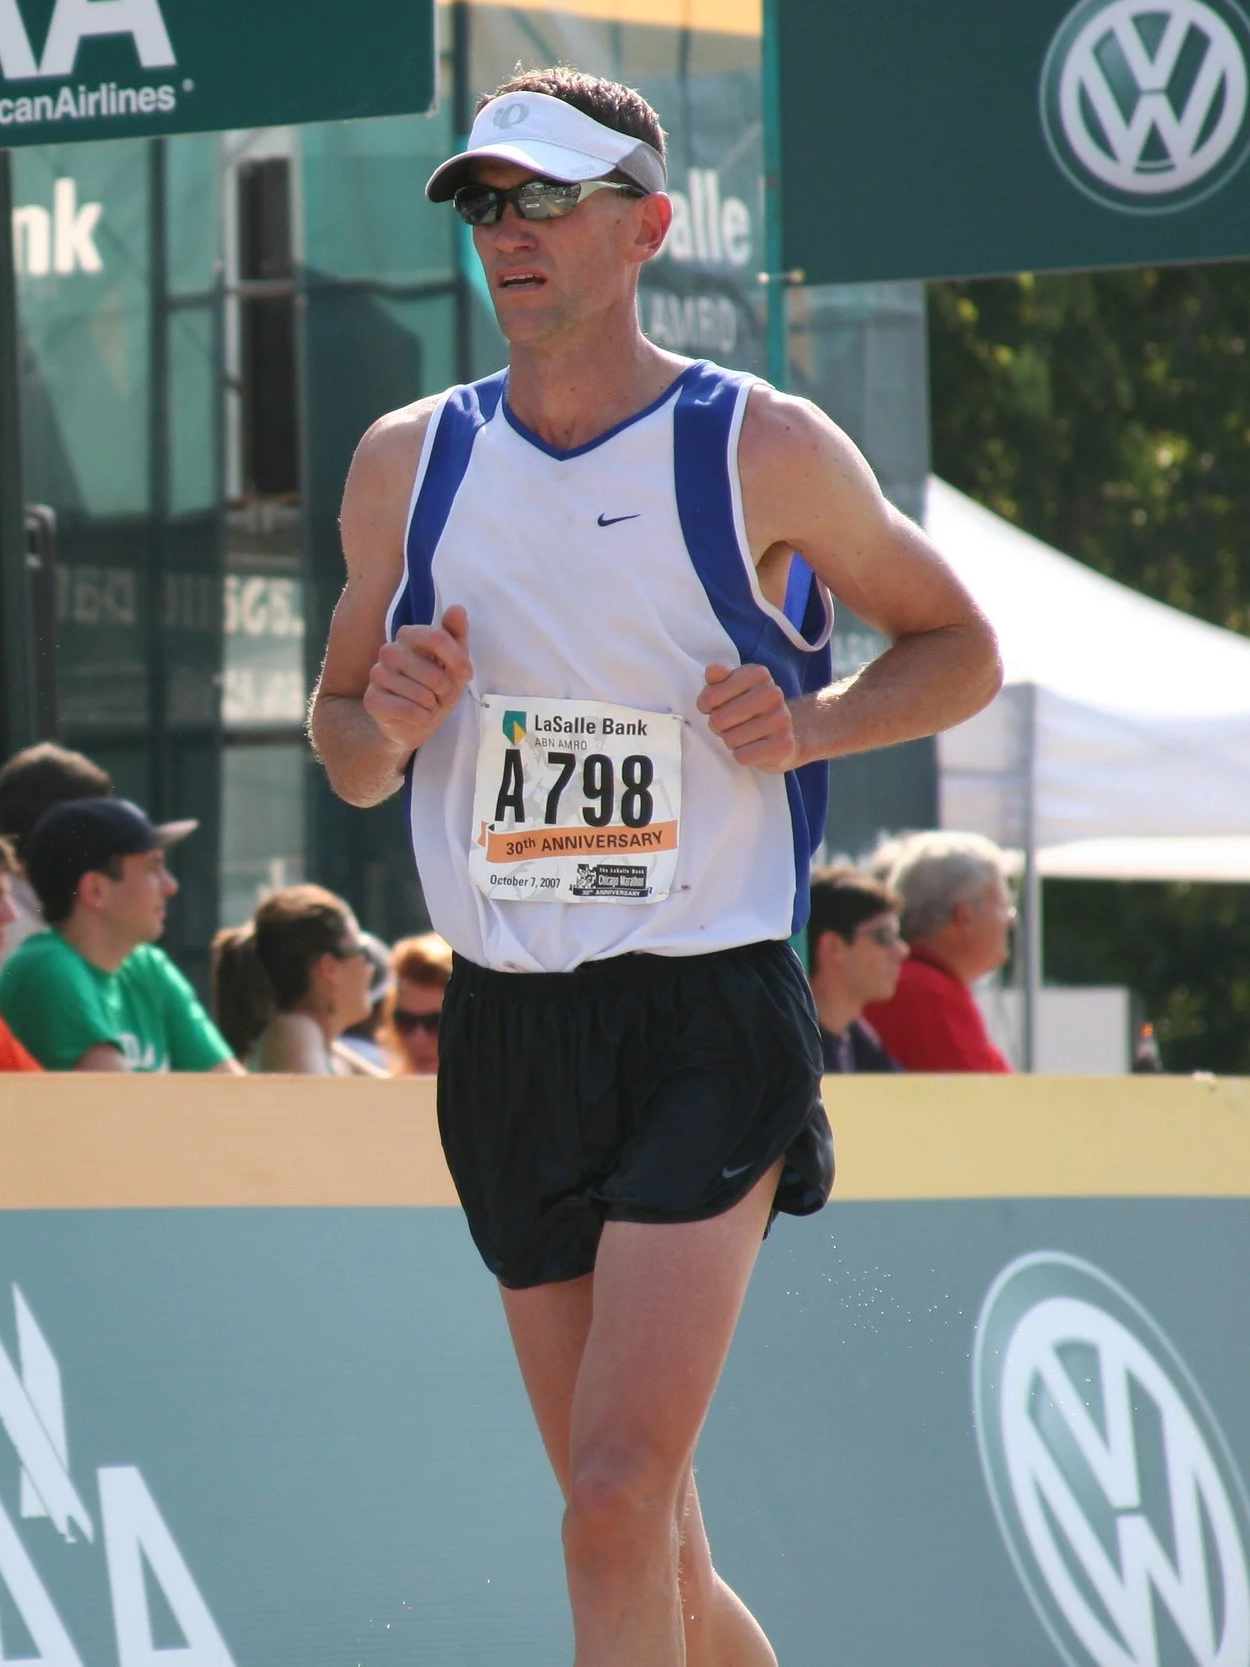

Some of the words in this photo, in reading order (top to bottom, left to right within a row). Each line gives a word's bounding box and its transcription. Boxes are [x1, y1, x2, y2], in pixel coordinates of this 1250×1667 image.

[534, 714, 597, 735] LaSalle
[602, 717, 648, 737] Bank
[534, 737, 556, 748] ABN
[558, 739, 588, 751] AMRO
[544, 751, 654, 829] 798
[506, 837, 537, 855] 30th
[541, 830, 664, 853] ANNIVERSARY
[490, 874, 528, 887] October
[530, 877, 539, 888] 7,
[540, 877, 561, 888] 2007
